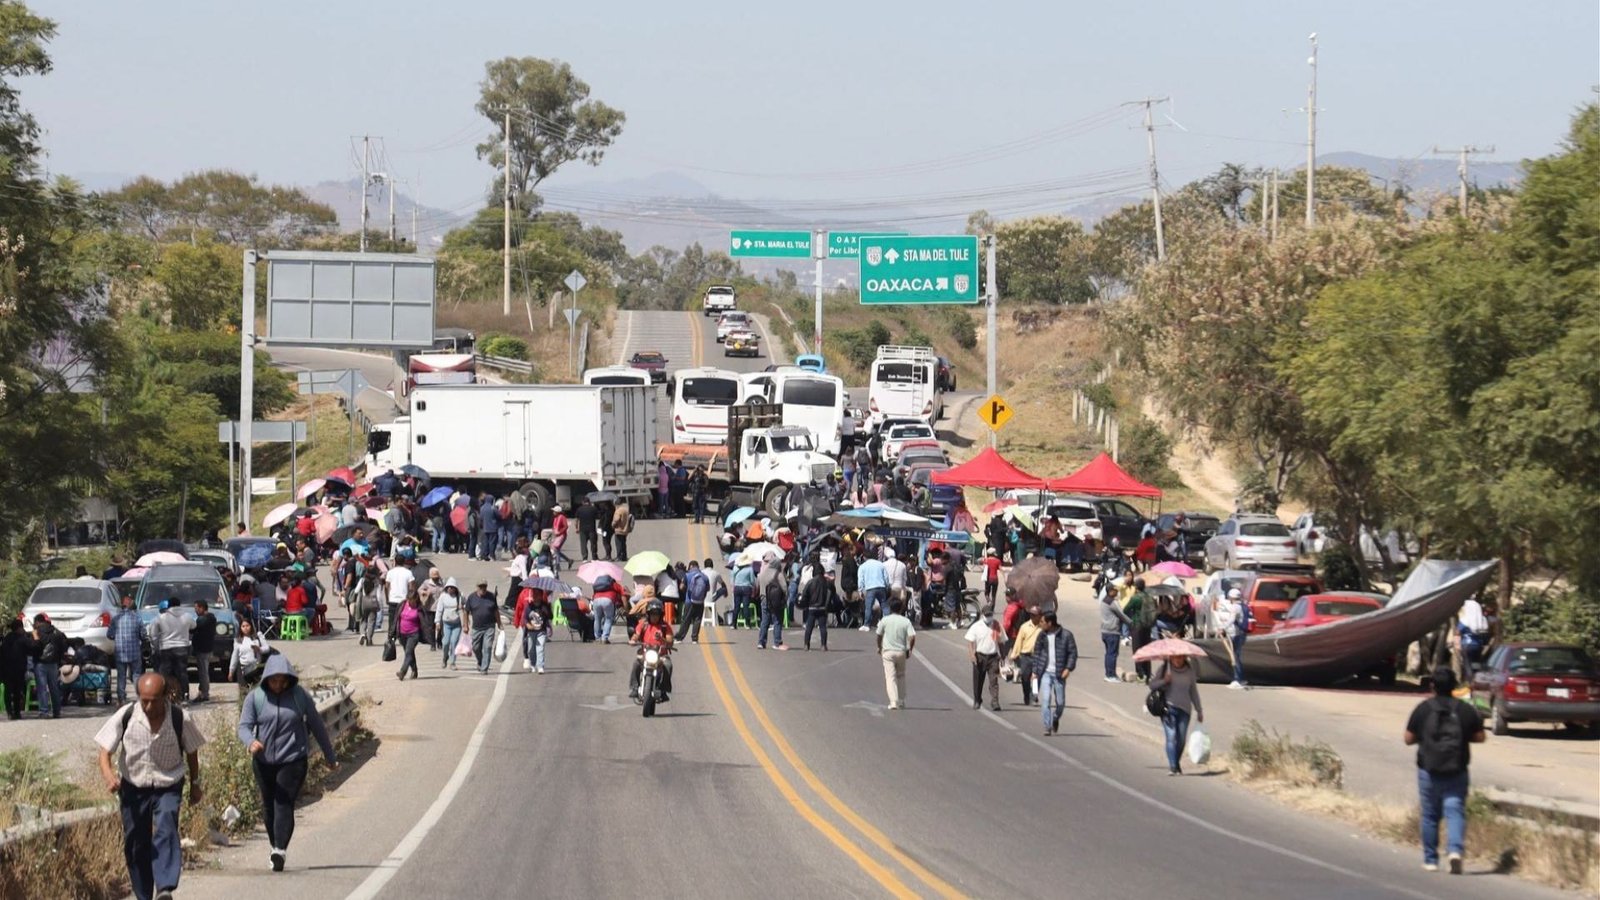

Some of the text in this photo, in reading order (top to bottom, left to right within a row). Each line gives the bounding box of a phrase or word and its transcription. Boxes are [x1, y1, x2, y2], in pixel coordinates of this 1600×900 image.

[767, 240, 786, 249] MARIA
[786, 240, 794, 249] EL
[795, 241, 810, 249] TULE
[903, 248, 969, 261] STA MA DEL TULE
[866, 278, 934, 292] OAXACA
